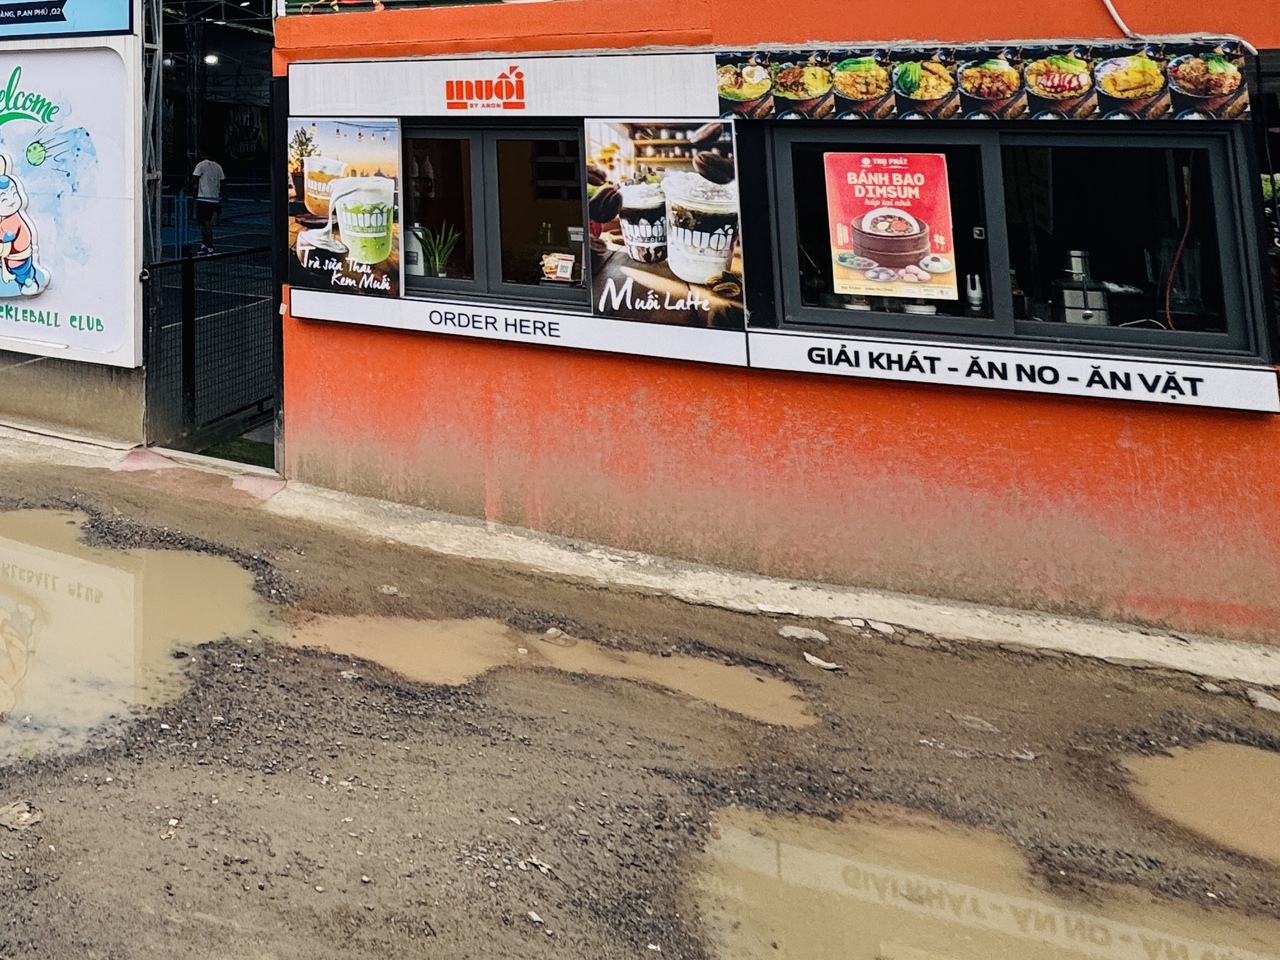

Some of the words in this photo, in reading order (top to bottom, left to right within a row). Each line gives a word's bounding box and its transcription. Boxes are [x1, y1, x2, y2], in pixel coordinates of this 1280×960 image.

[847, 169, 890, 185] BÁNH
[892, 173, 925, 186] BAO
[854, 185, 920, 199] DIMSUM
[299, 246, 321, 268] Trà
[331, 270, 357, 286] Kem
[664, 290, 711, 311] Latte
[70, 315, 104, 332] CLUB
[429, 310, 498, 331] ORDER
[504, 317, 561, 338] HERE
[807, 345, 860, 368] GIẢI
[868, 350, 941, 375] KHÁT
[965, 356, 1008, 381] ĂN
[1016, 363, 1060, 385] NO
[1086, 365, 1132, 391] ĂN
[1138, 366, 1204, 400] VẶT
